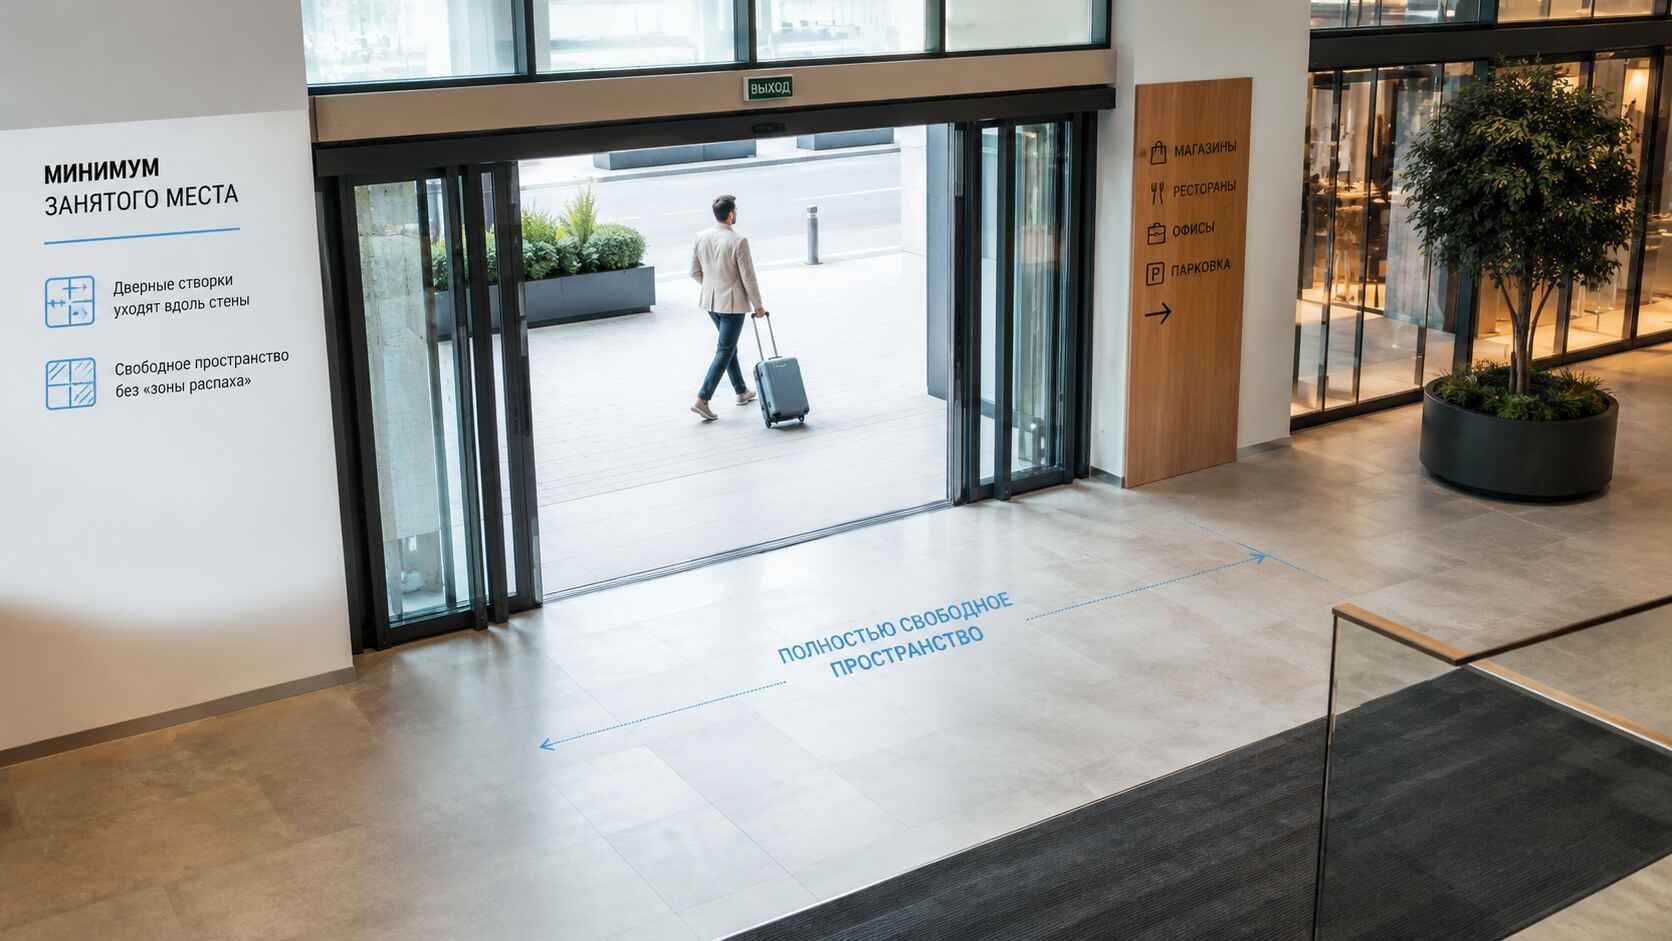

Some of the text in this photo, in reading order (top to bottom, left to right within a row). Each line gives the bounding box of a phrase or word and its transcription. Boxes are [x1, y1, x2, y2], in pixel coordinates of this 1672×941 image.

[751, 81, 791, 95] ВЫХОД
[1174, 141, 1237, 157] МАГАЗИНЫ
[1173, 180, 1236, 198] РЕСТОРАНЫ
[1172, 221, 1215, 238] ОФИСЫ
[1171, 258, 1231, 277] ПАРКОВКА
